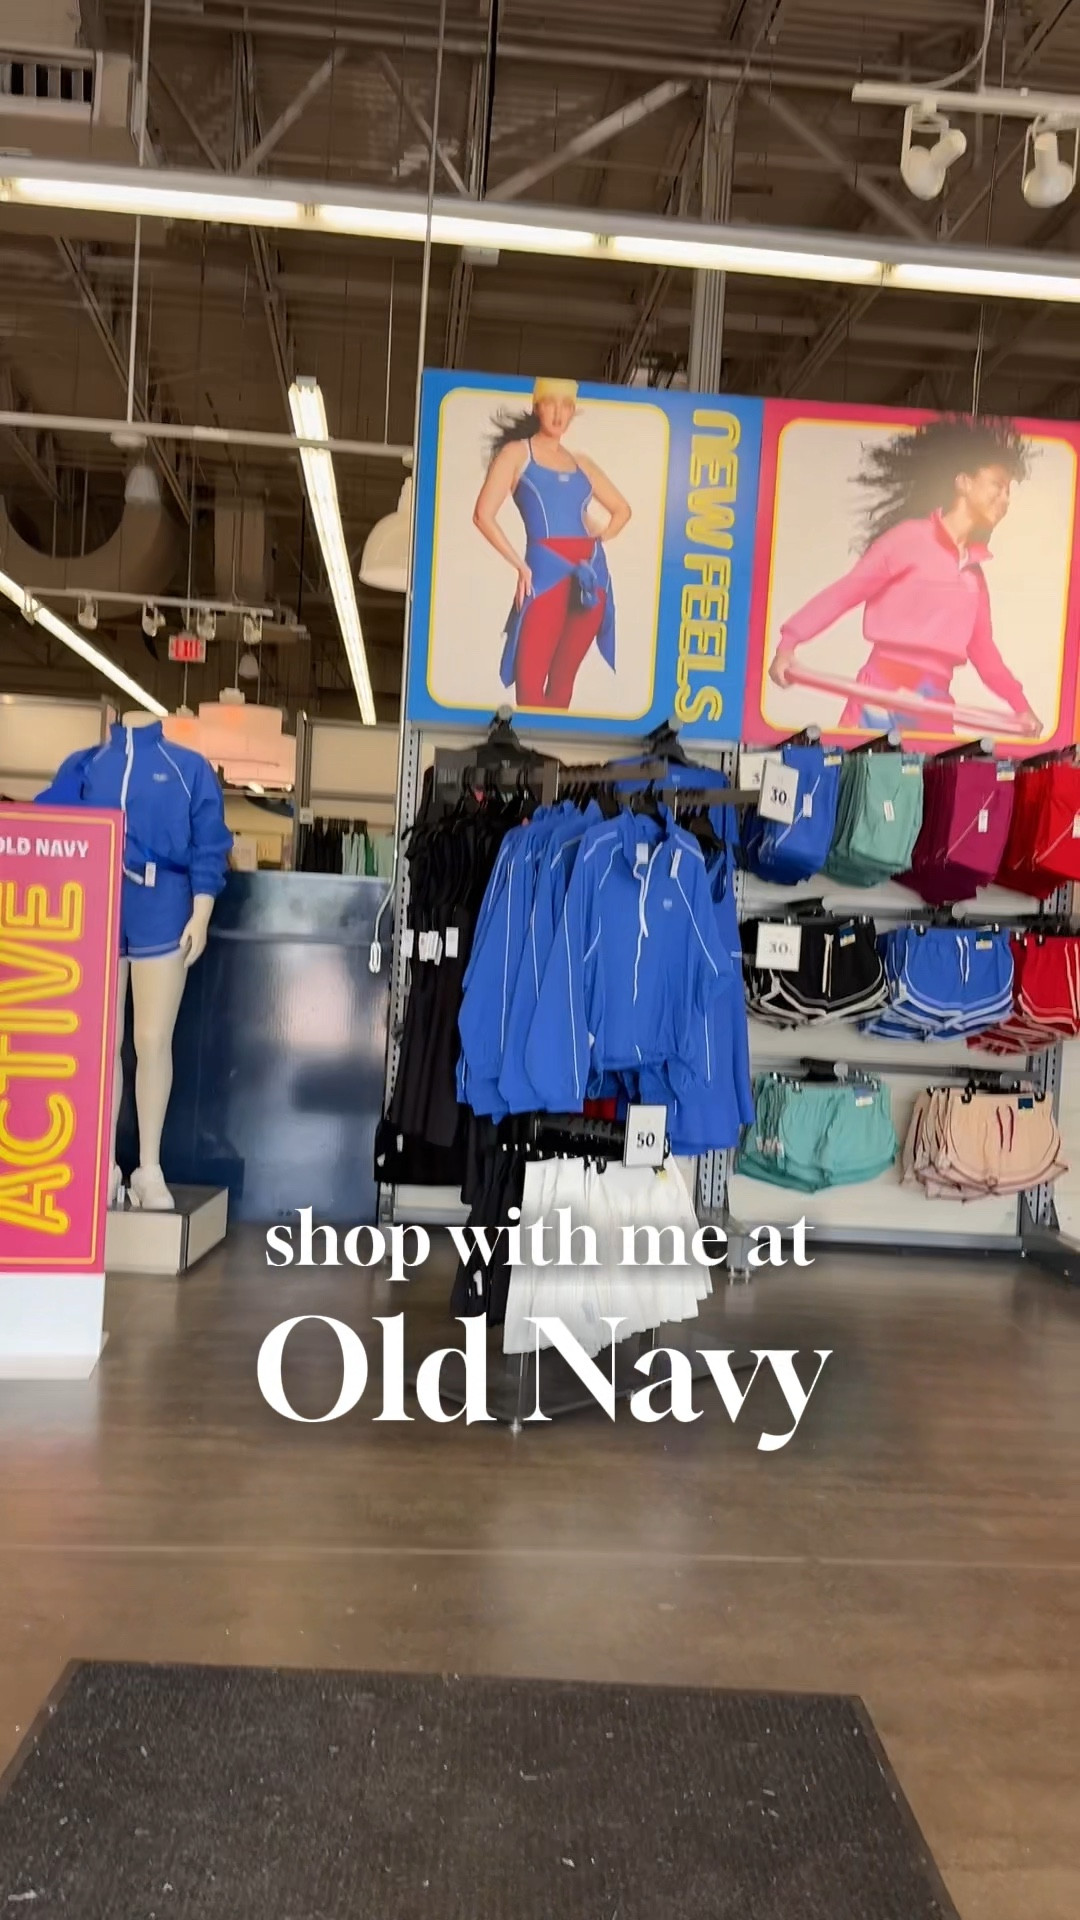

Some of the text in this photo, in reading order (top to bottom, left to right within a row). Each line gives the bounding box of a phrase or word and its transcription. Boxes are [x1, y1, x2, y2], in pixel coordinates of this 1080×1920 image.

[674, 409, 741, 723] NEW FEELS
[35, 838, 89, 858] NAVY
[0, 881, 83, 1234] ACTIVE
[637, 1131, 656, 1149] 50
